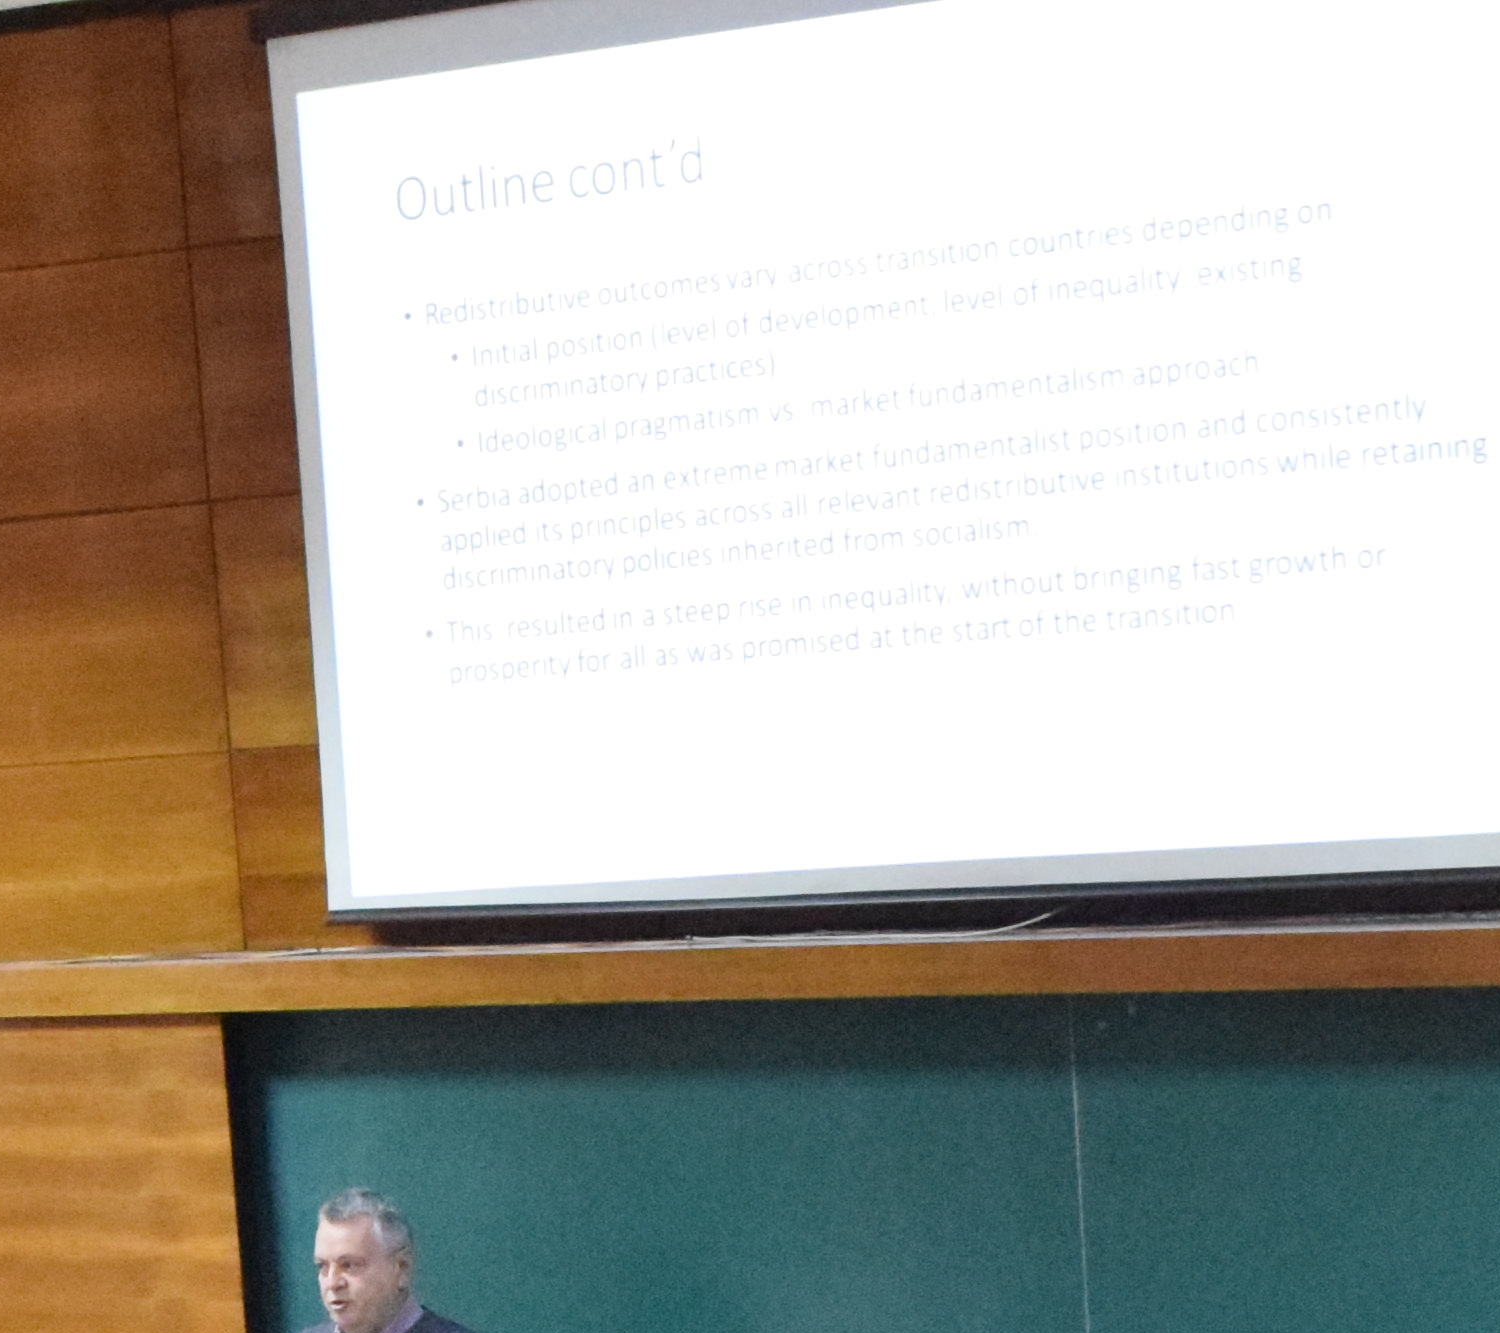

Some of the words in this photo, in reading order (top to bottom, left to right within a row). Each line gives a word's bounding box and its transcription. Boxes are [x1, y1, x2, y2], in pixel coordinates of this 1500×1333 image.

[396, 165, 554, 220] Outline
[568, 135, 703, 199] cont'd
[425, 289, 591, 325] Redistributive
[597, 273, 721, 306] outcomes
[725, 267, 777, 290] vary
[788, 255, 868, 283] across
[875, 240, 999, 273] transition
[1008, 225, 1133, 258] countries
[1141, 205, 1290, 243] depending
[1297, 201, 1333, 225] on
[471, 337, 539, 367] Initial
[546, 329, 643, 365] position
[651, 316, 717, 351] (level
[725, 311, 750, 339] of
[943, 285, 1003, 313] level
[1013, 278, 1039, 307] of
[1197, 255, 1303, 287] existing
[474, 371, 649, 408] discriminatory
[655, 351, 776, 393] practices)
[477, 417, 607, 454] Ideological
[614, 405, 759, 444] pragmatism
[811, 389, 901, 417] market
[907, 367, 1125, 409] fundamentalism
[1132, 349, 1259, 389] approach
[437, 485, 511, 514] Serbia
[517, 471, 619, 505] adopted
[627, 473, 655, 494] an
[663, 461, 769, 491] extreme
[775, 449, 865, 477] market
[871, 429, 1071, 469] fundamentalist
[1079, 421, 1187, 454] position
[1197, 409, 1247, 439] and
[1255, 393, 1427, 433] consistently
[441, 521, 527, 555] applied
[536, 521, 563, 543] its
[570, 507, 687, 545] principles
[695, 501, 773, 527] across
[781, 493, 809, 519] all
[817, 485, 921, 515] relevant
[929, 471, 1106, 505] redistributive
[1115, 456, 1269, 487] institutions
[1275, 444, 1351, 474] while
[1361, 436, 1489, 467] retaining
[442, 557, 615, 591] discriminatory
[622, 547, 713, 579] policies
[721, 531, 835, 563] inherited
[843, 529, 904, 553] from
[445, 619, 493, 644] This
[507, 607, 606, 639] resulted
[613, 610, 633, 629] in
[642, 608, 656, 628] a
[663, 601, 731, 625] steep
[739, 597, 783, 618] rise
[791, 594, 812, 613] in
[961, 571, 1065, 600] without
[1073, 563, 1183, 594] bringing
[1191, 555, 1241, 581] fast
[1249, 545, 1347, 585] growth
[1357, 547, 1387, 570] or
[449, 655, 571, 689] prosperity
[577, 648, 611, 673] for
[619, 644, 646, 671] all
[655, 647, 679, 667] as
[686, 642, 734, 664] was
[741, 627, 861, 665] promised
[869, 627, 893, 649] at
[901, 622, 944, 647] the
[952, 617, 1012, 643] start
[1018, 611, 1045, 639] of
[1053, 609, 1097, 635] the
[1105, 603, 1235, 631] transition
